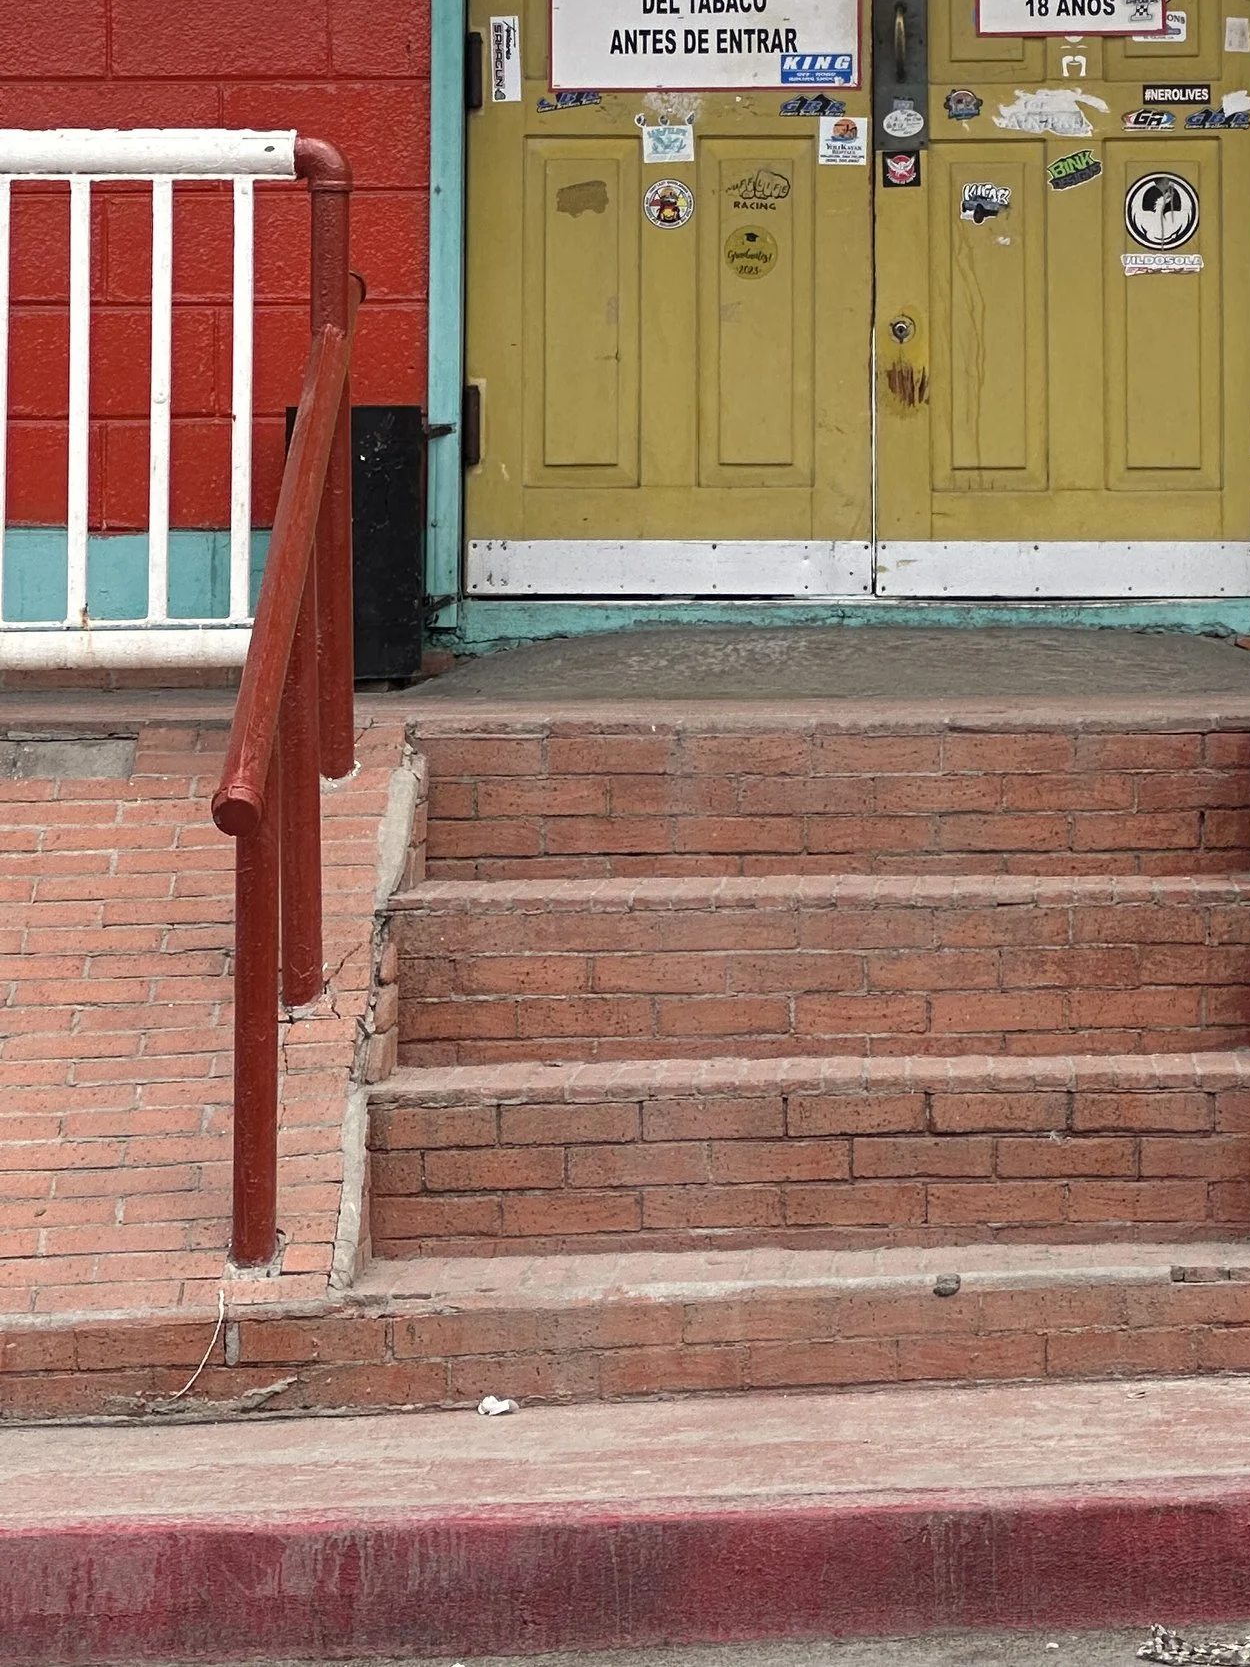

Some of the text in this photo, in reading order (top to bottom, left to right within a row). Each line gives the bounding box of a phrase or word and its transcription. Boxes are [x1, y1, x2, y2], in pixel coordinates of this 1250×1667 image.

[609, 28, 798, 55] ANTES DE ENTRAR
[783, 56, 851, 70] KING
[1144, 88, 1209, 101] #NEROLIVES
[1050, 150, 1094, 178] BINK
[733, 201, 777, 210] RACING
